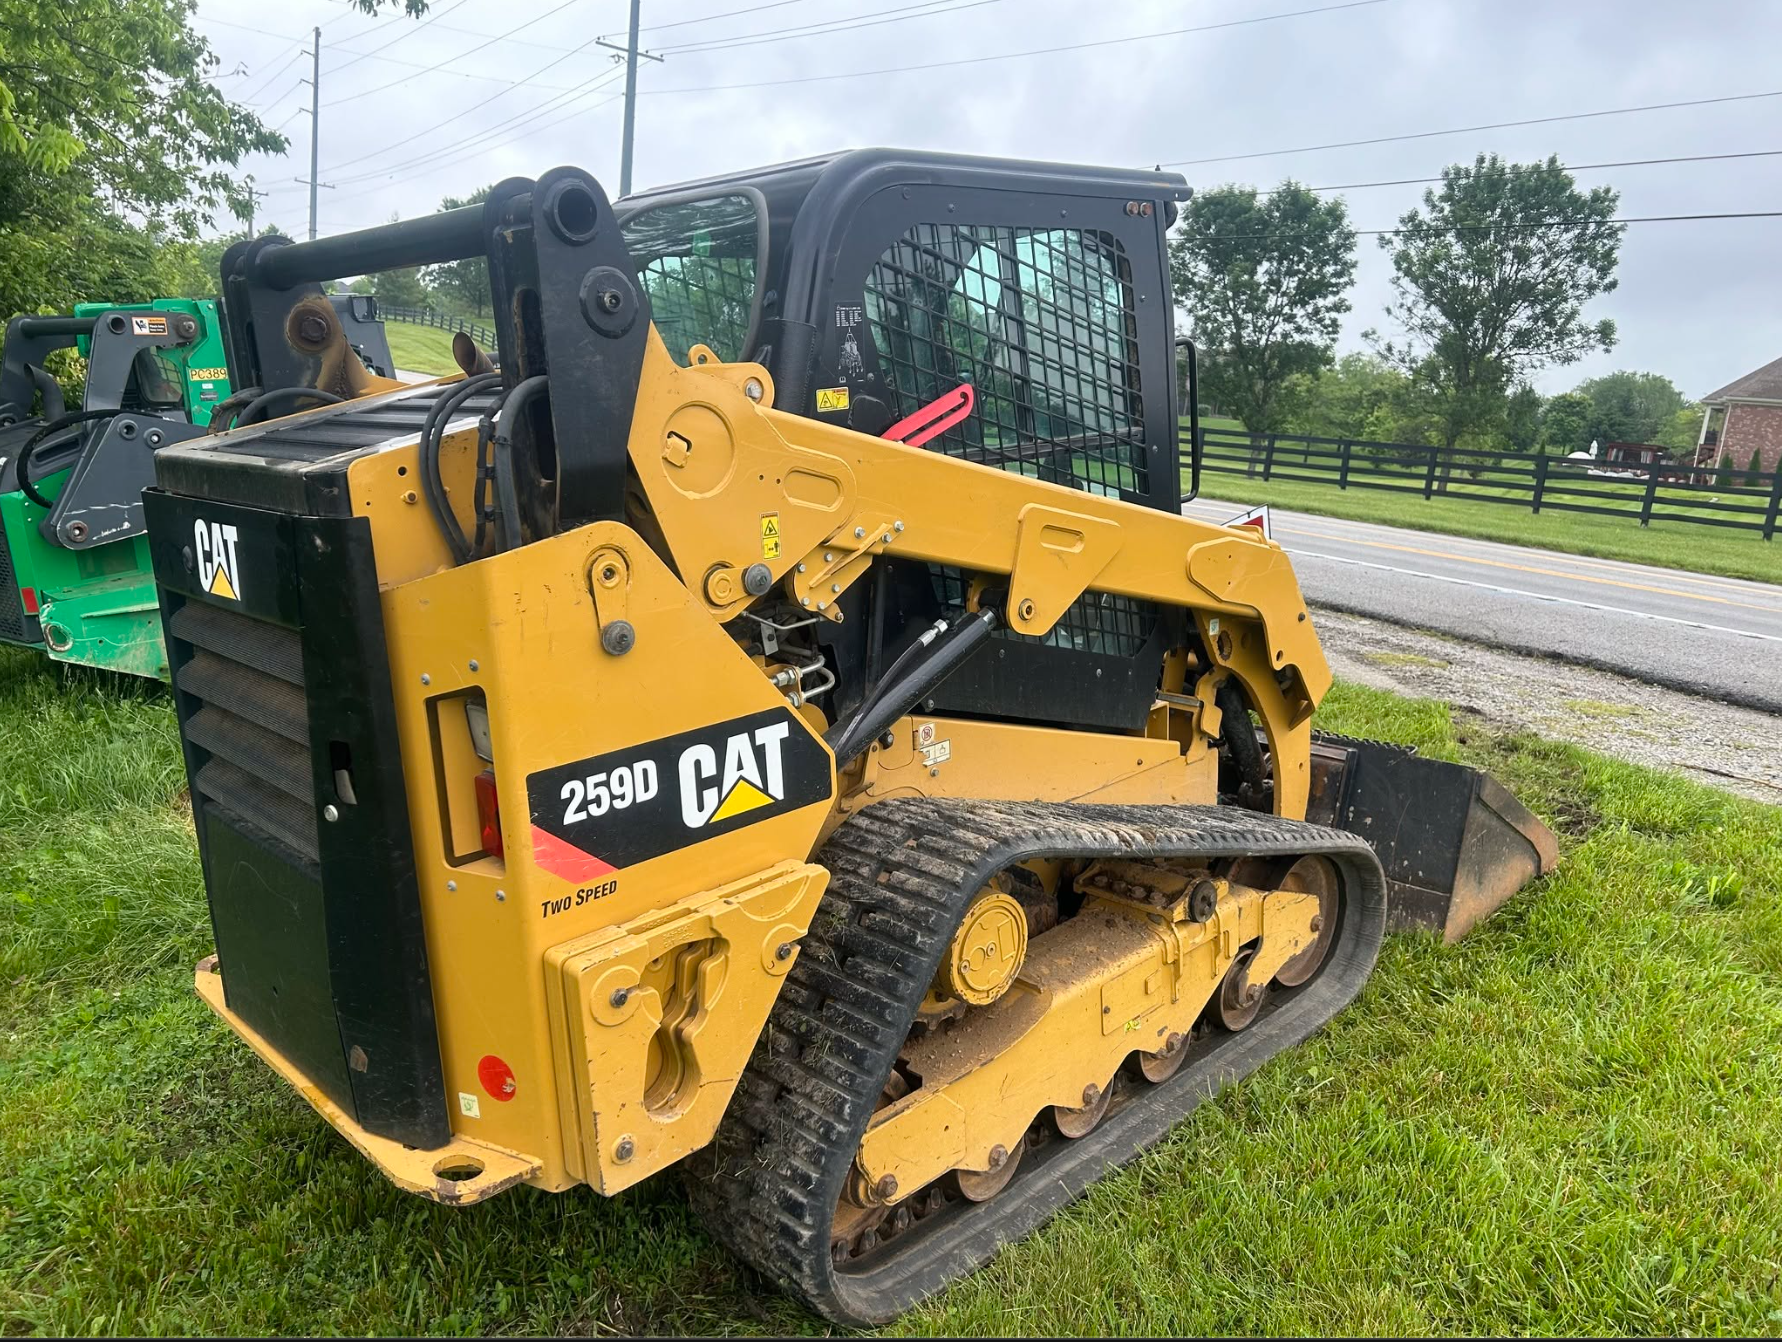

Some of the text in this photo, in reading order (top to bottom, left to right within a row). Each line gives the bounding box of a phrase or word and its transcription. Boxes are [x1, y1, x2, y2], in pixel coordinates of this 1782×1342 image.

[190, 368, 227, 380] PC389
[194, 518, 241, 601] CAT
[560, 720, 790, 829] 259D CAT
[541, 880, 618, 919] TWO SPEED
